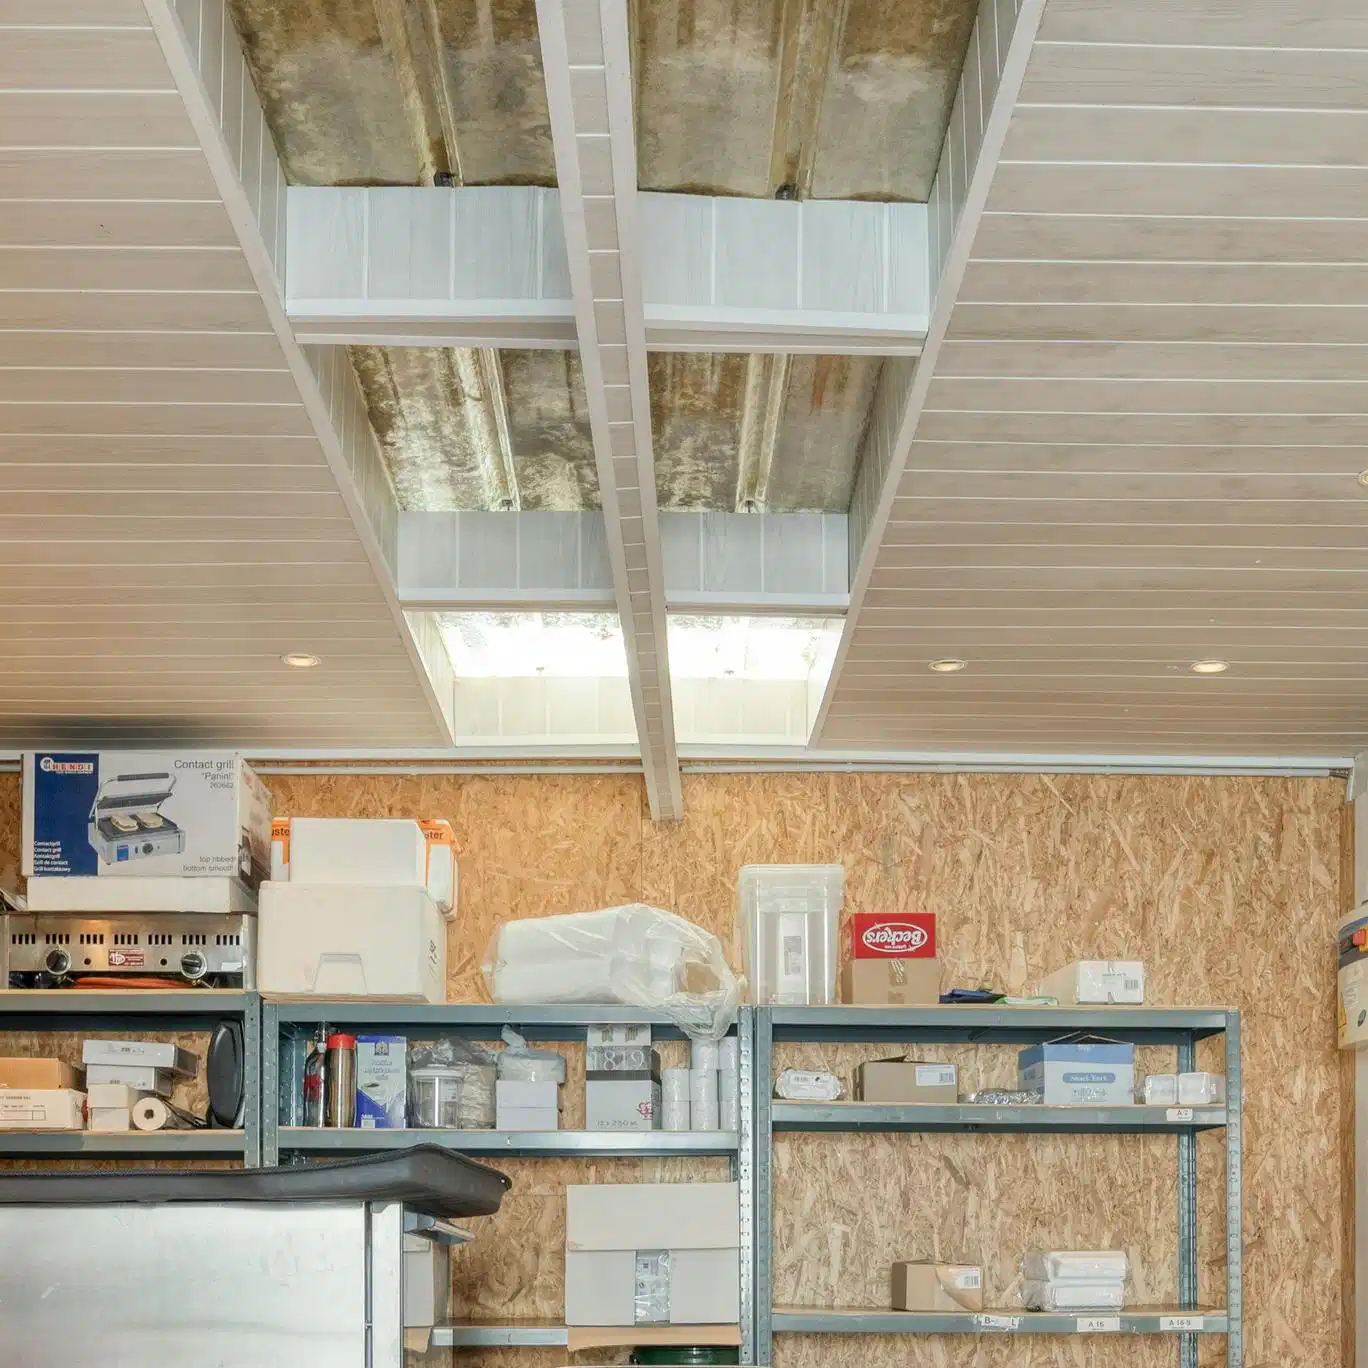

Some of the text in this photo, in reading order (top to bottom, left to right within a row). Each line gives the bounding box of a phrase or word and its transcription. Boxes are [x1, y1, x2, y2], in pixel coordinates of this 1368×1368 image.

[174, 759, 234, 771] Contact grill
[866, 926, 923, 946] Beckers
